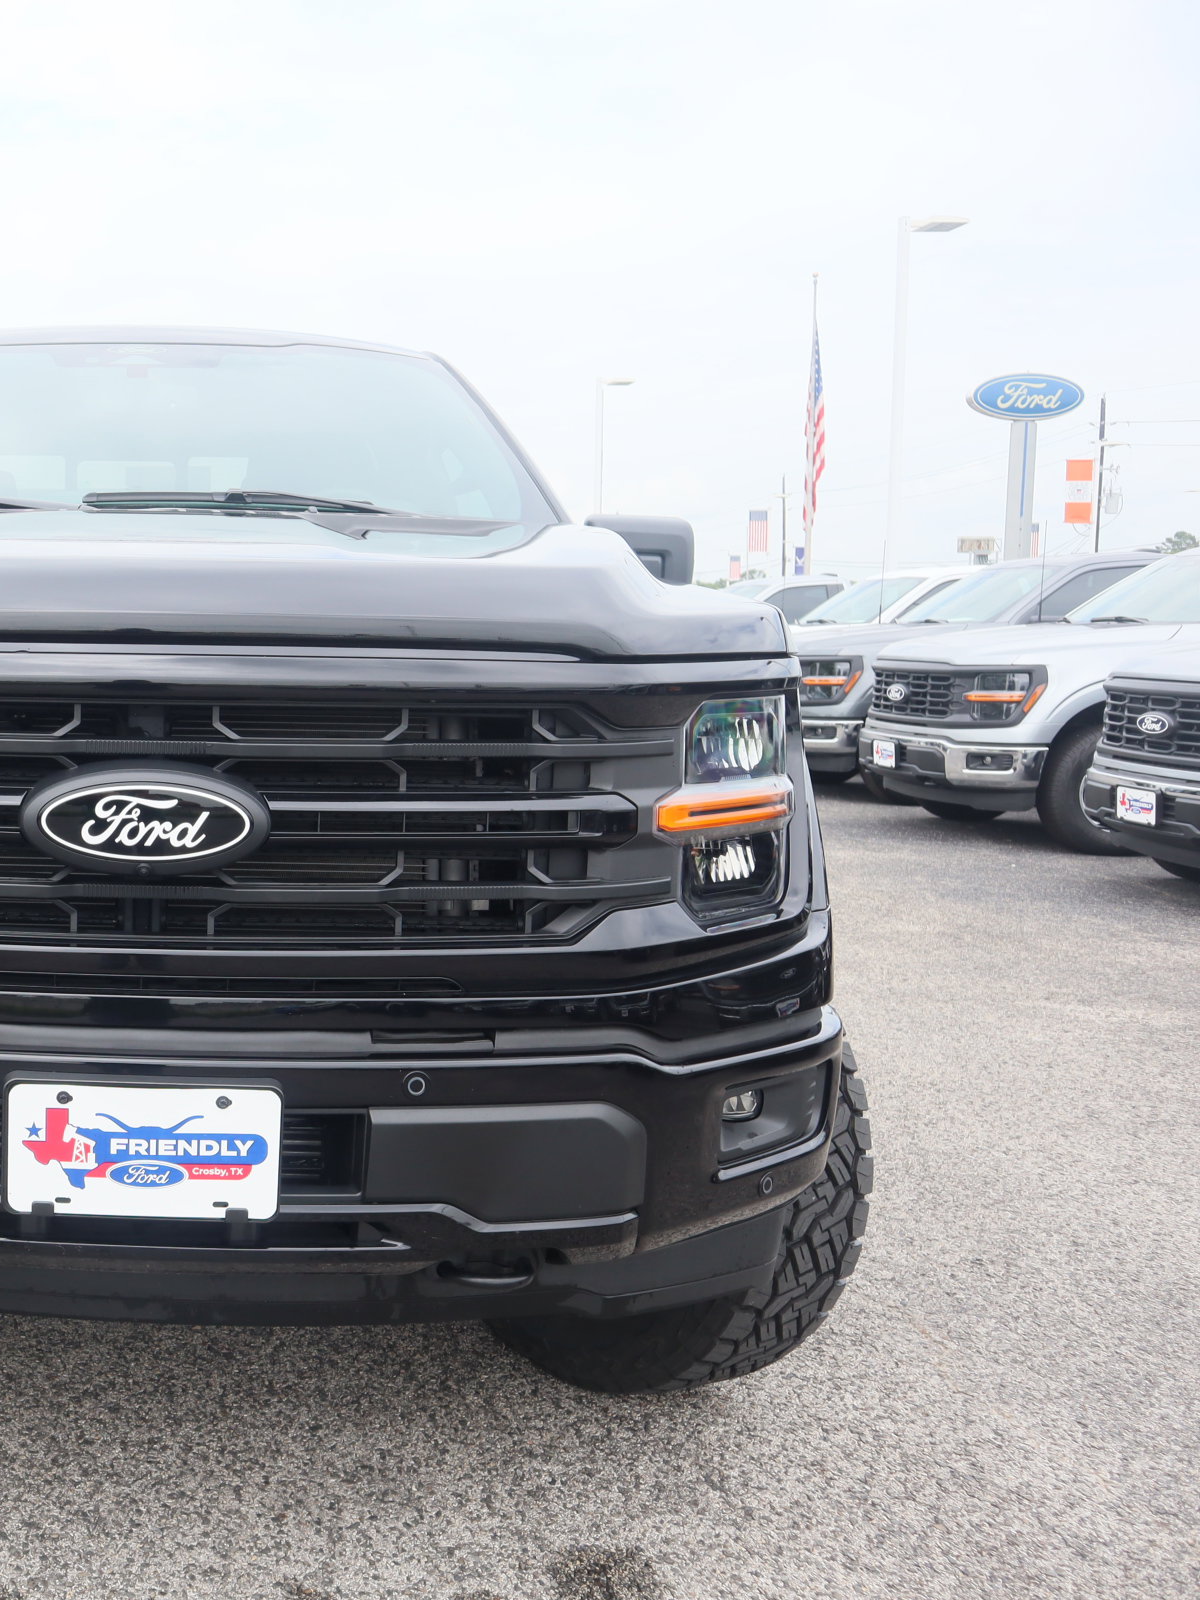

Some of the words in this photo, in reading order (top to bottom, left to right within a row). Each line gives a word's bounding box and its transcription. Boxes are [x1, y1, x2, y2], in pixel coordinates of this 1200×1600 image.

[997, 381, 1064, 409] Ford
[1142, 717, 1162, 730] Ford
[81, 795, 210, 848] Ford
[110, 1138, 255, 1157] FRIENDLY
[123, 1164, 171, 1184] Ford
[192, 1167, 229, 1177] Crosby,
[230, 1167, 244, 1176] TX
